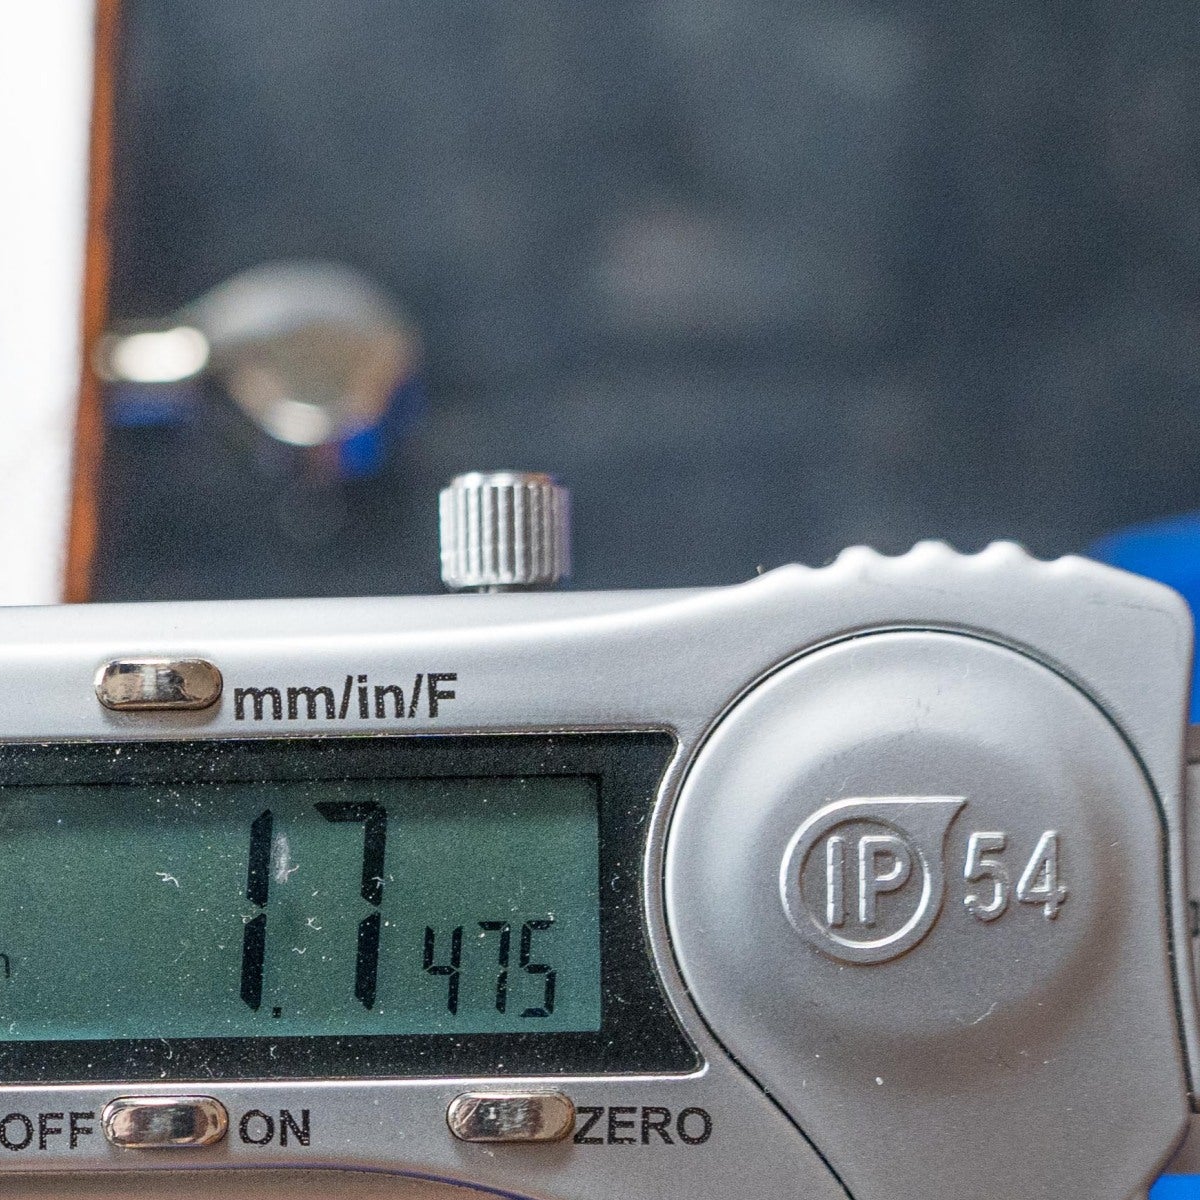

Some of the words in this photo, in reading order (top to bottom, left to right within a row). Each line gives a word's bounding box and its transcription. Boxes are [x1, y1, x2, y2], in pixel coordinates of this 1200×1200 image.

[233, 671, 458, 721] mm/in/F
[826, 835, 912, 927] IP
[963, 830, 1068, 922] 54
[238, 1108, 312, 1147] ON
[572, 1106, 713, 1146] ZERO
